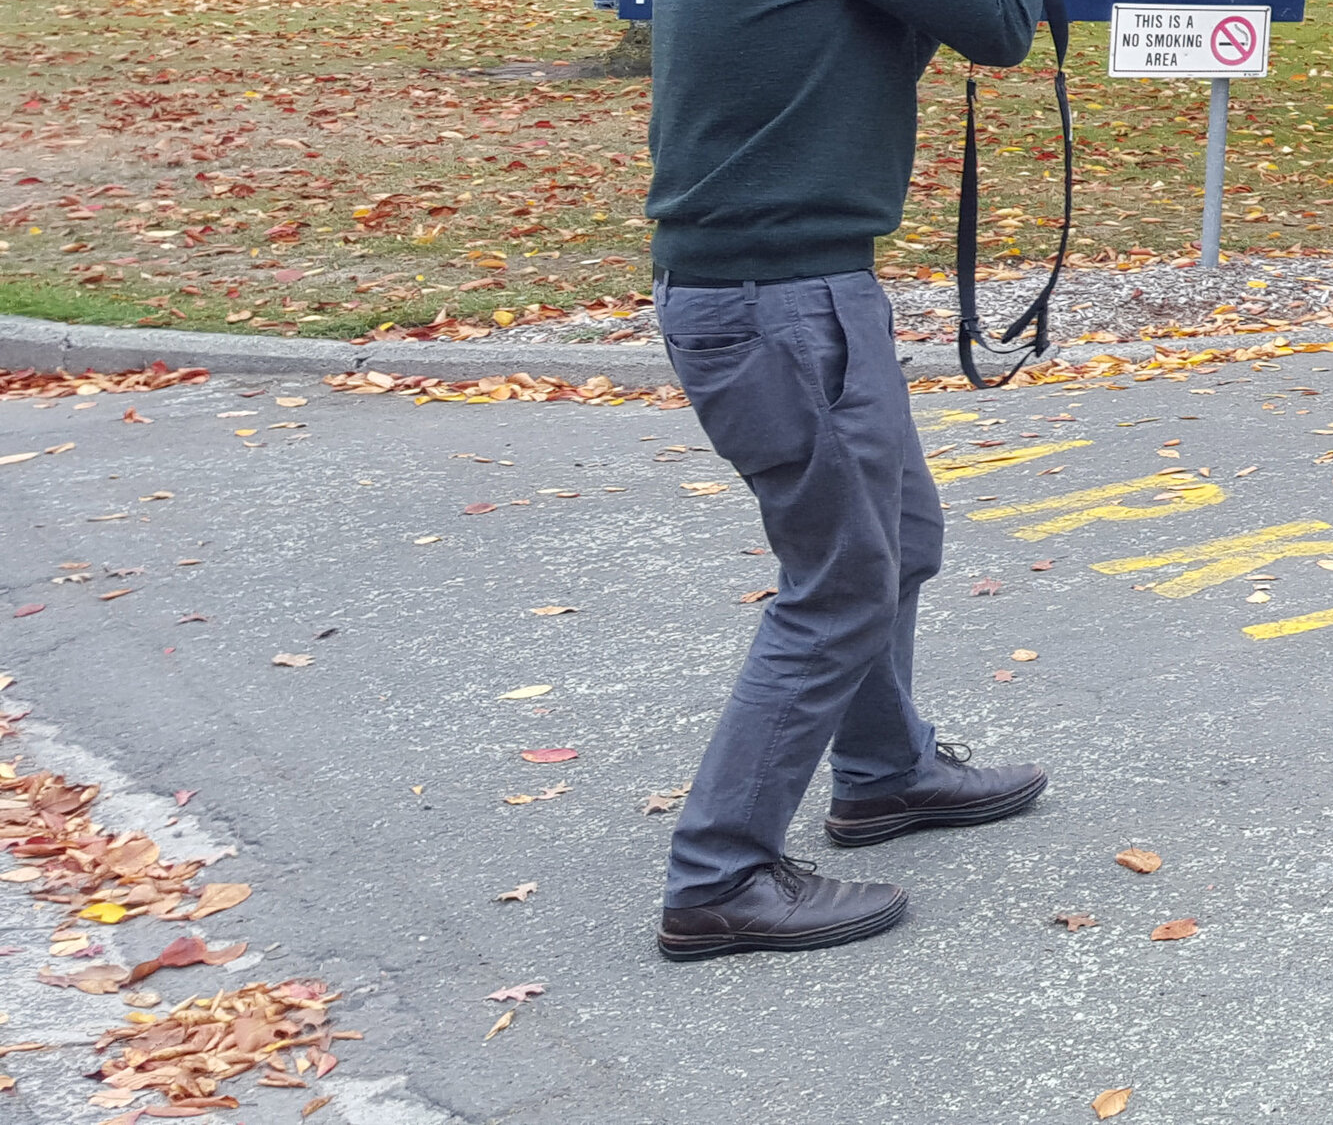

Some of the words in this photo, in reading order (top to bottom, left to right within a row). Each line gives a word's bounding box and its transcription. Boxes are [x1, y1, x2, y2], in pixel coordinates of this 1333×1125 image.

[1135, 14, 1163, 29] THIS
[1168, 15, 1181, 29] IS
[1186, 15, 1194, 29] A
[1122, 33, 1140, 47] NO
[1145, 34, 1203, 48] SMOKING
[1145, 52, 1178, 66] AREA
